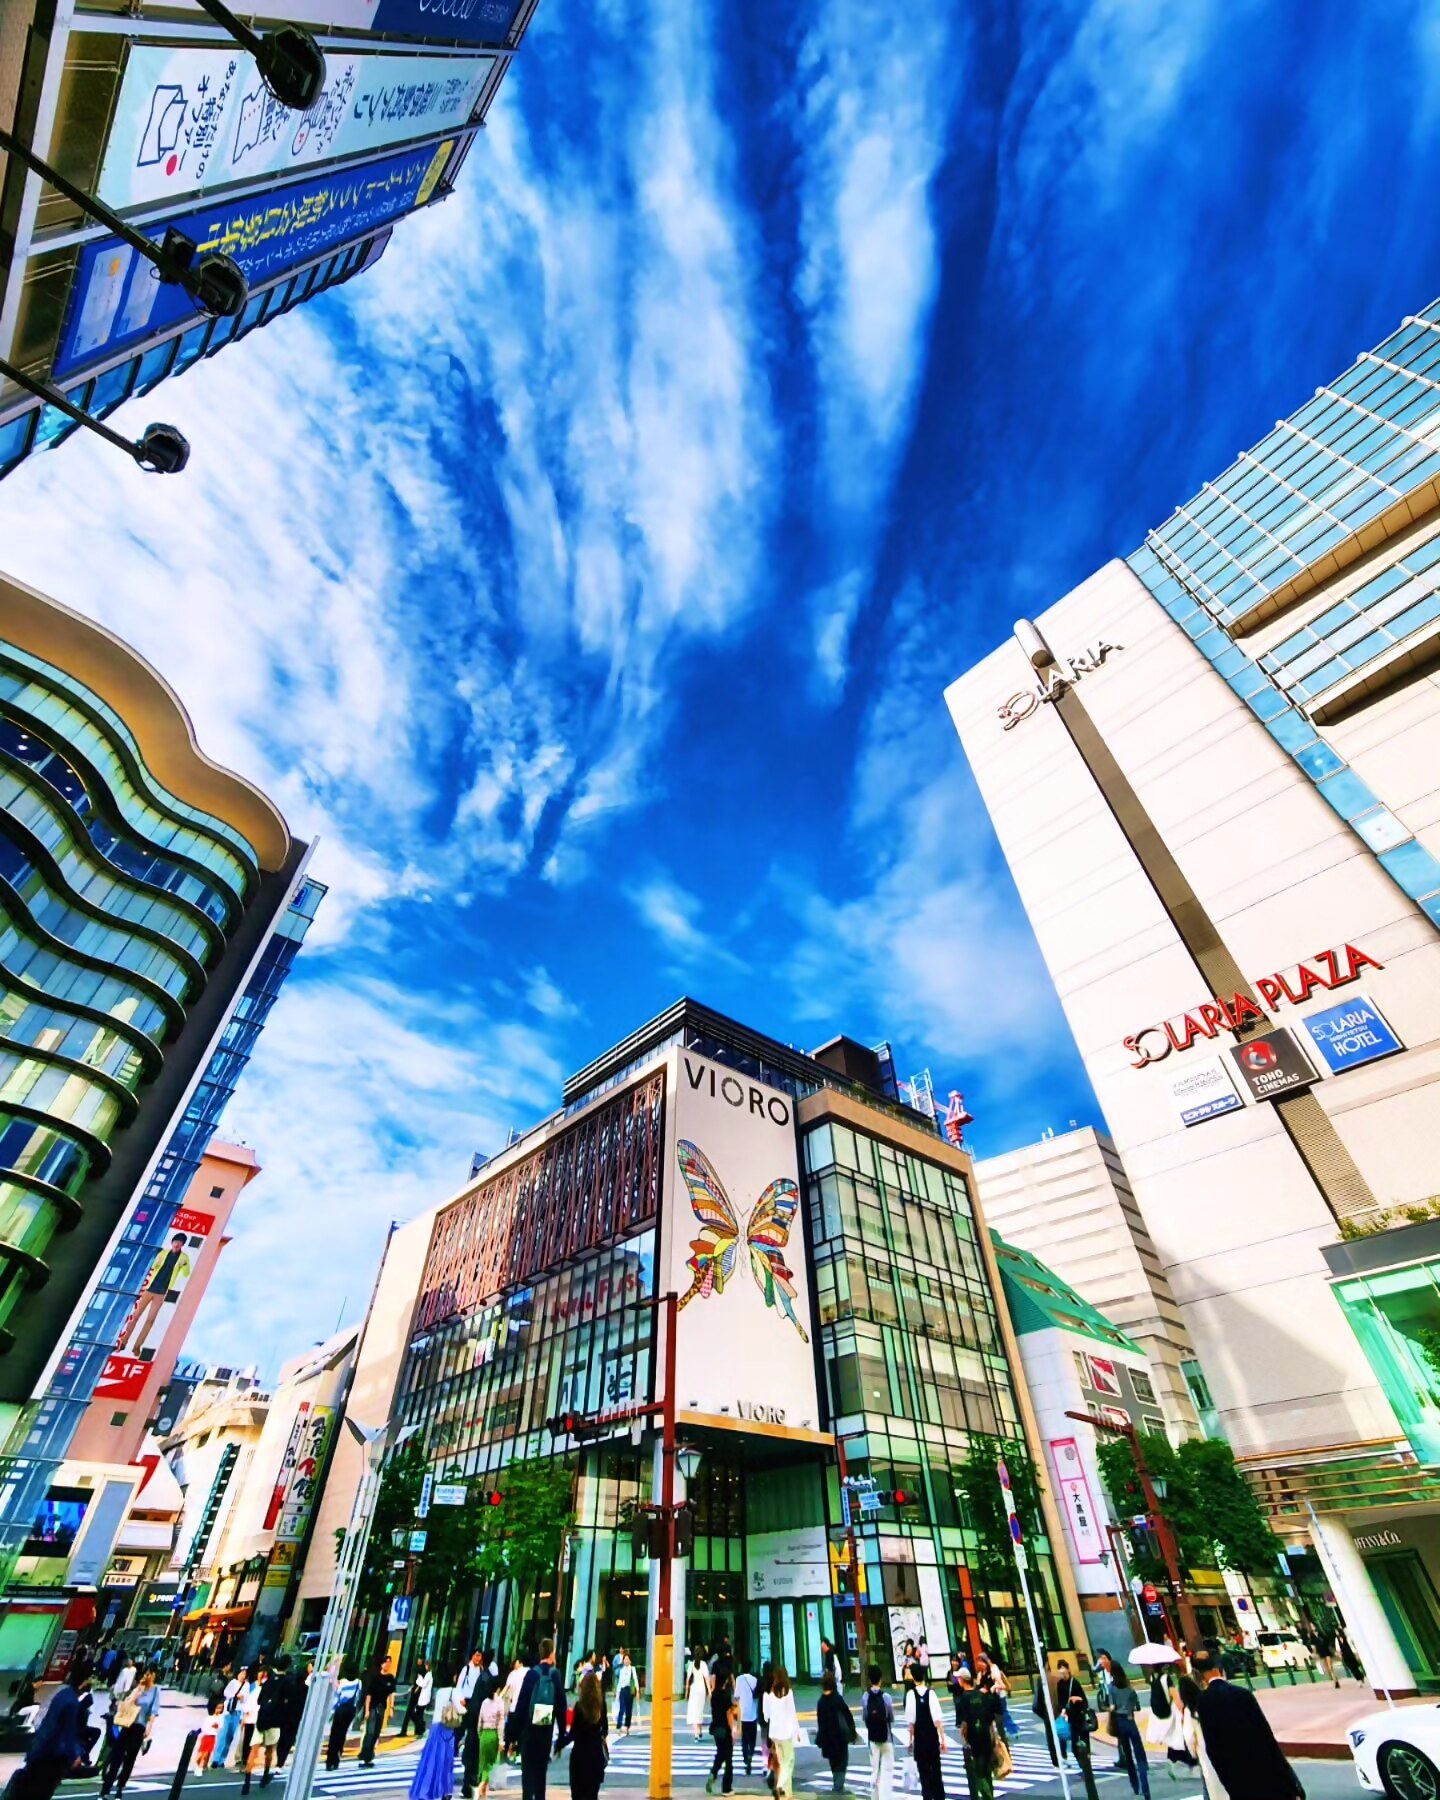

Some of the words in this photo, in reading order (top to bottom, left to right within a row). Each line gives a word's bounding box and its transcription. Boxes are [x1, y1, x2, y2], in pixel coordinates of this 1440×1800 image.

[997, 641, 1124, 730] SOLARIA
[1123, 992, 1265, 1068] SOLARIA
[1256, 943, 1385, 1012] PLAZA
[1312, 1009, 1375, 1040] SOLARIA
[1333, 1030, 1382, 1056] HOTEL
[1252, 1069, 1283, 1085] TOHO
[1257, 1073, 1300, 1093] CINEMAS
[684, 1057, 789, 1126] VIORO
[171, 1217, 206, 1233] PLAZA
[123, 1364, 145, 1379] 1F
[737, 1400, 786, 1424] VIORO
